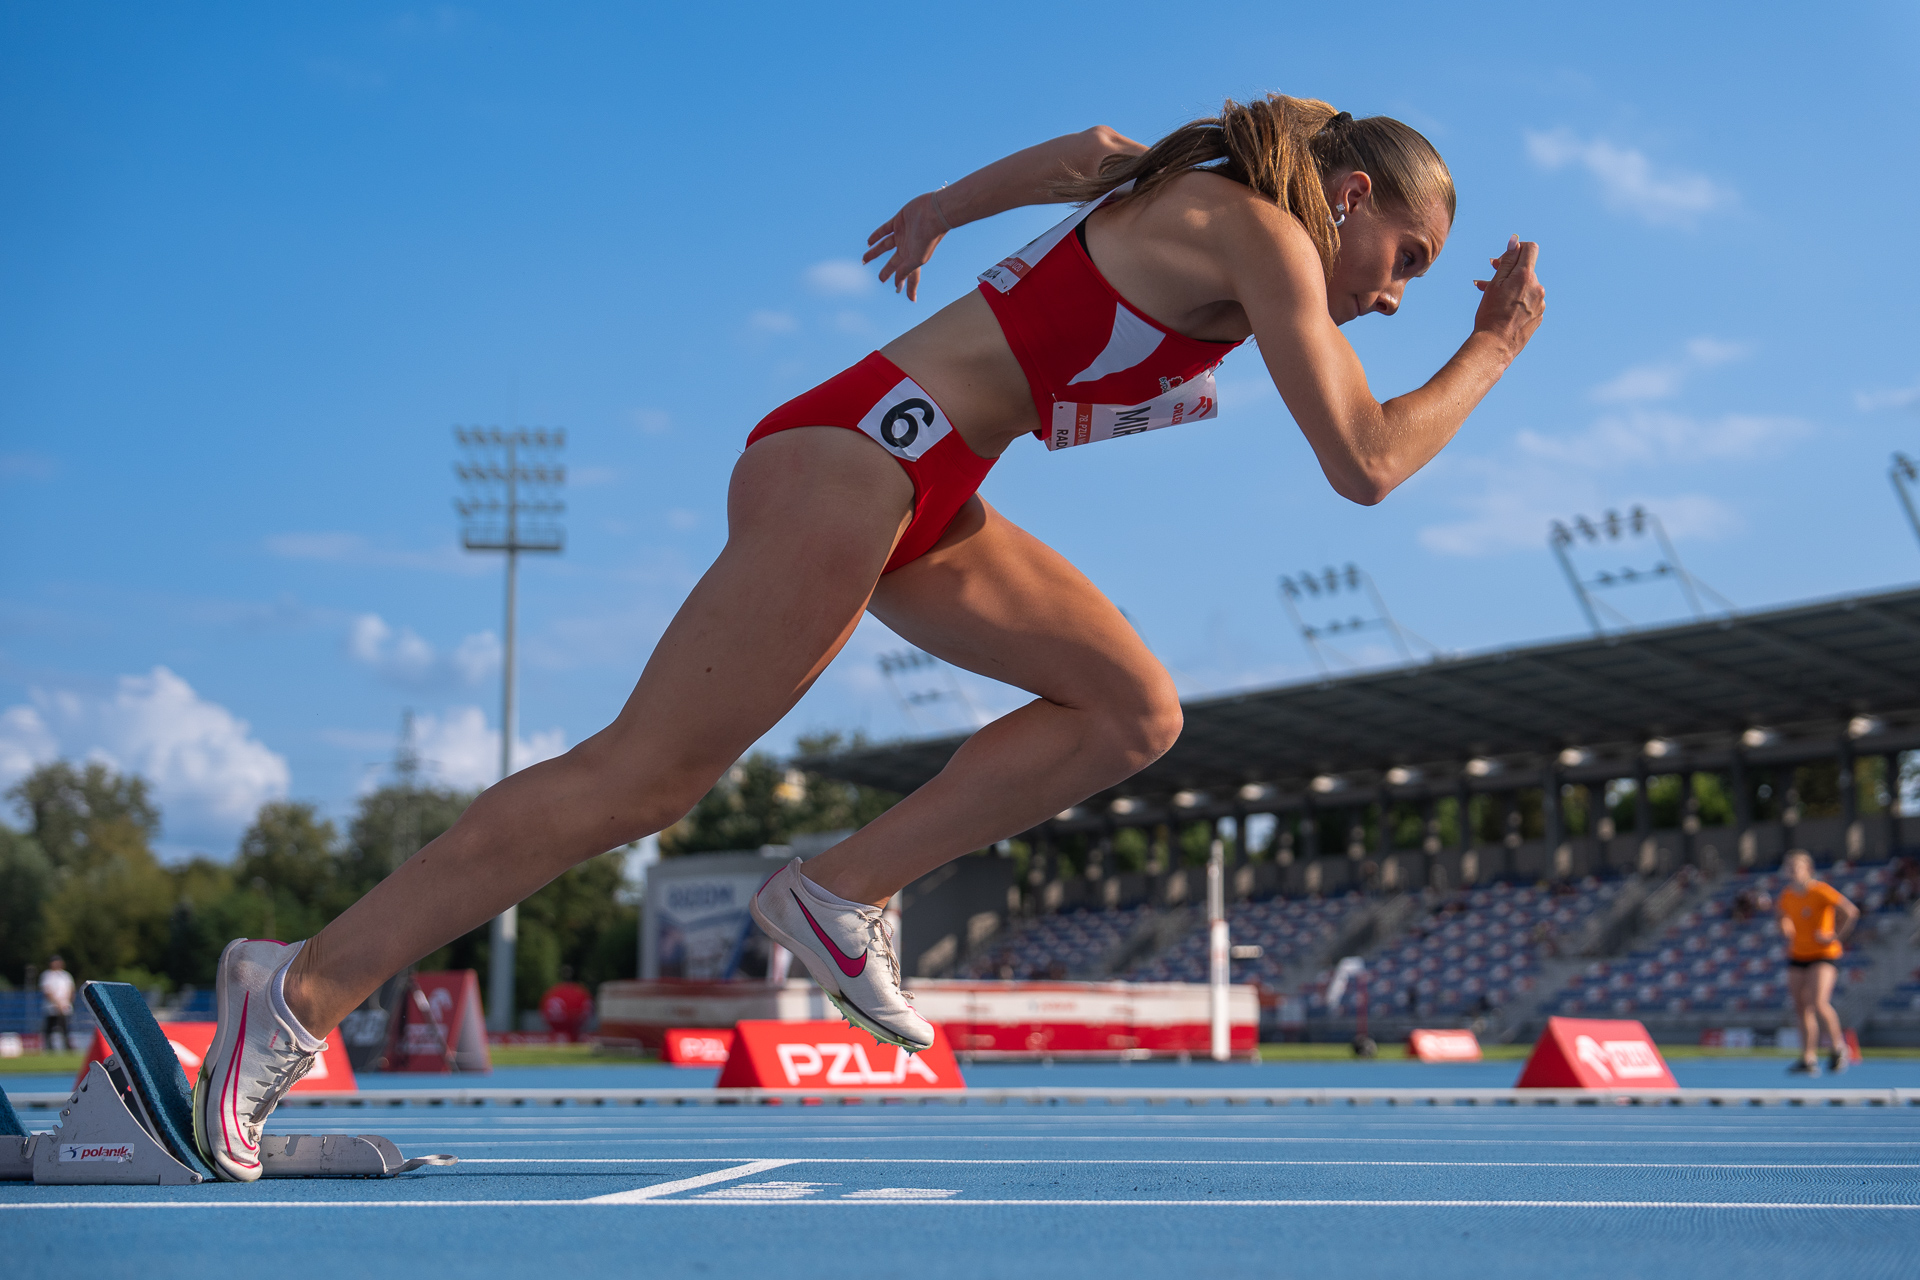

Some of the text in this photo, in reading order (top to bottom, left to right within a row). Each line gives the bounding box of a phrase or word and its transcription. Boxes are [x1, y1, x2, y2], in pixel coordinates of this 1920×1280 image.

[881, 398, 934, 448] 6
[1056, 429, 1069, 450] RAD
[776, 1043, 939, 1085] PZLA
[81, 1146, 128, 1159] polanik
